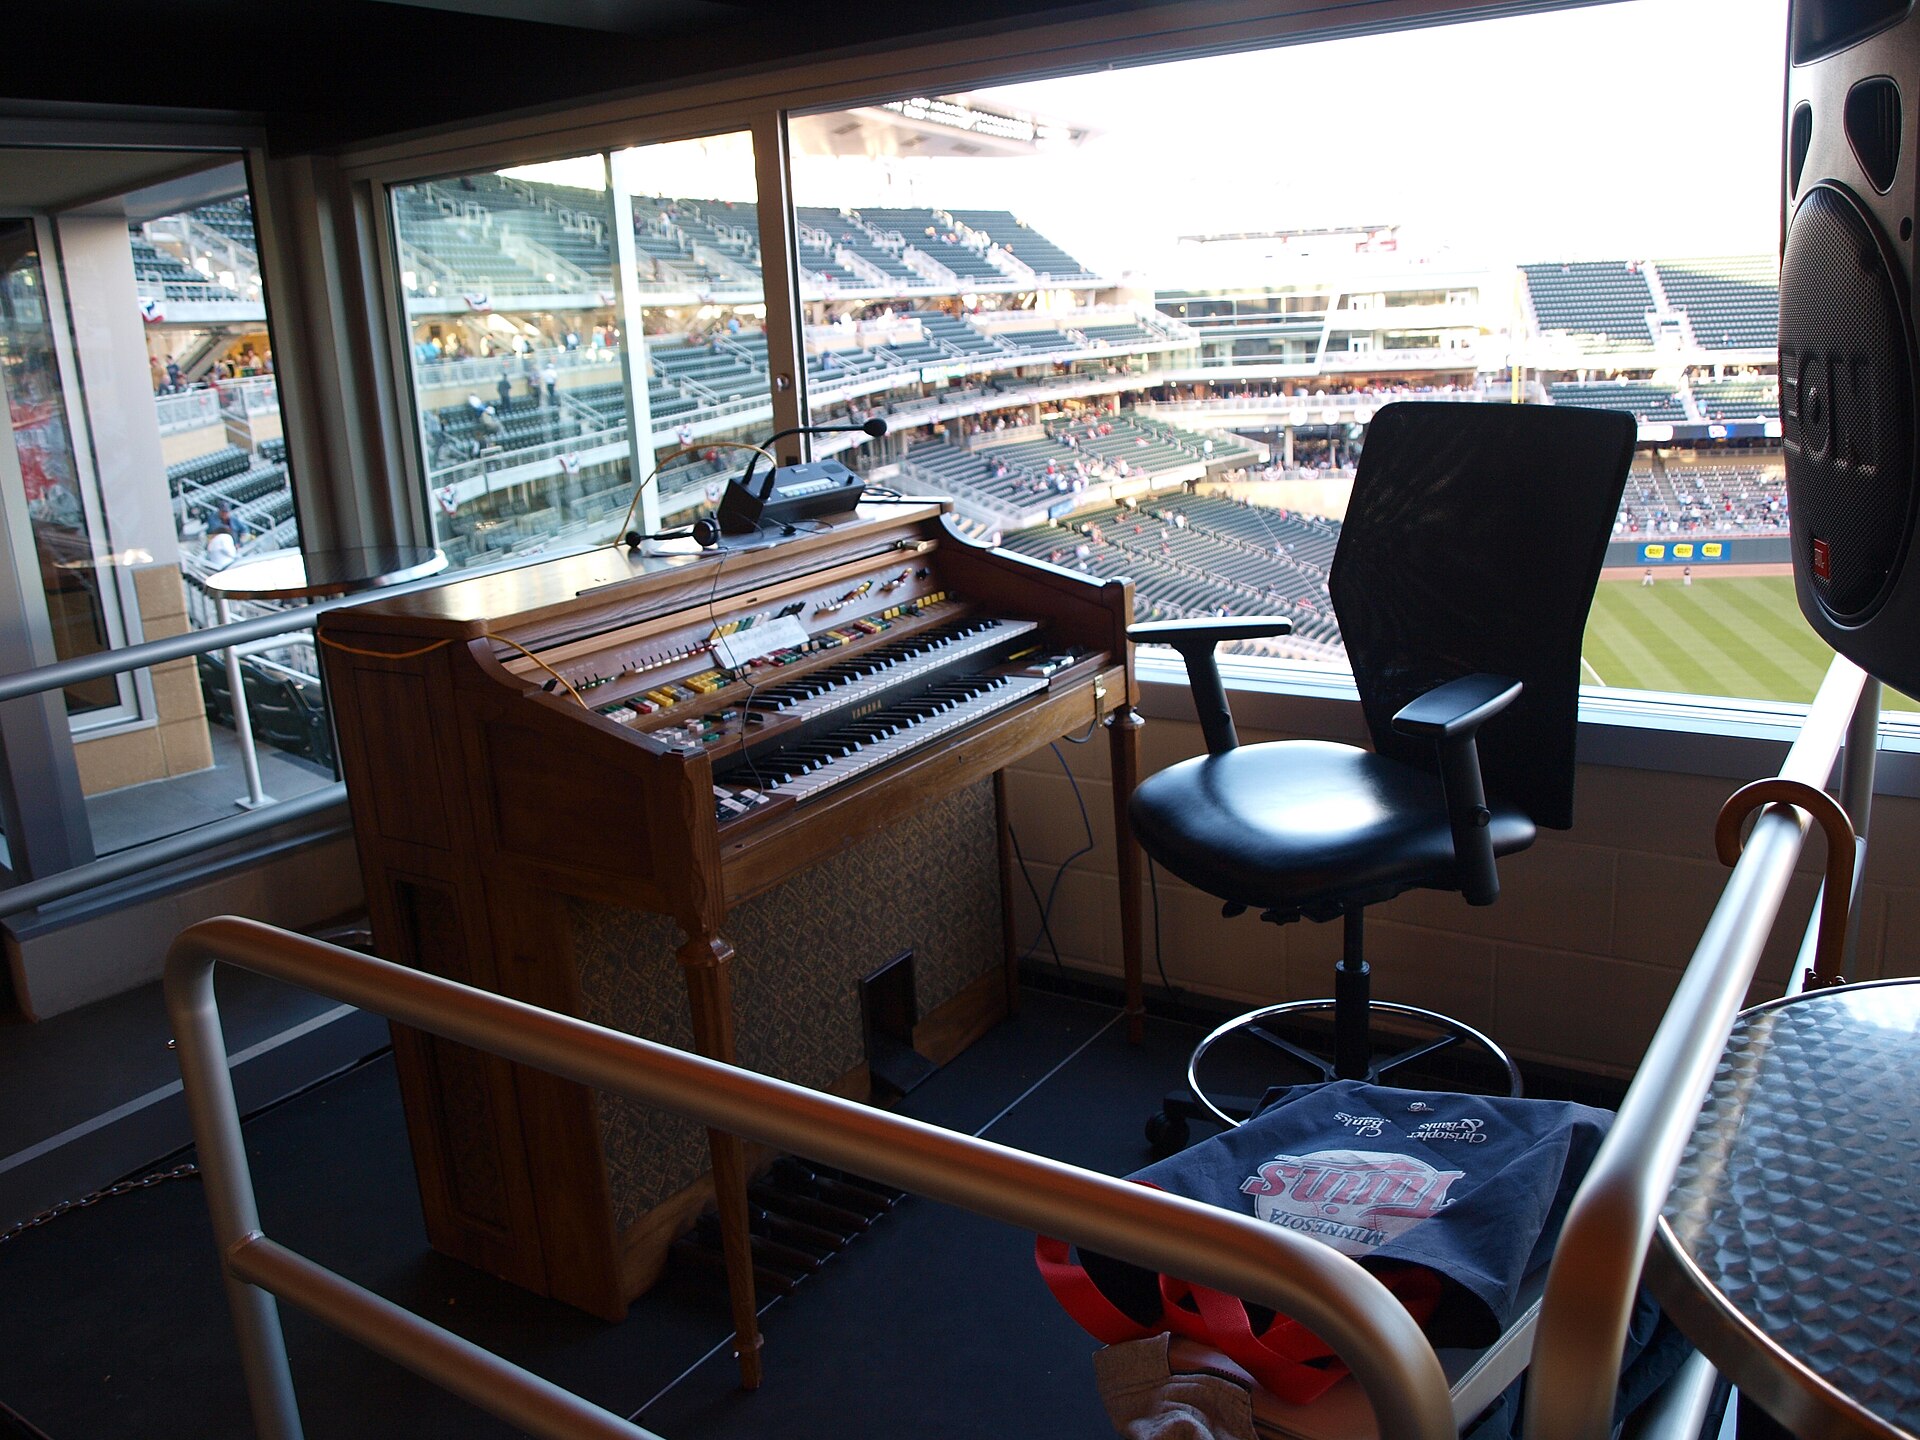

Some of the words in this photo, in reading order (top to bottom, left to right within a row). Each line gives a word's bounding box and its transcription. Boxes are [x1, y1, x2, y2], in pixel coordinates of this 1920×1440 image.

[852, 699, 883, 720] YAMAHA
[1333, 1113, 1385, 1130] Banks
[1418, 1121, 1459, 1132] Banks
[1455, 1118, 1485, 1133] &
[1406, 1130, 1488, 1144] Christopher
[1239, 1155, 1467, 1219] Twins
[1269, 1208, 1389, 1247] MINNESOTA
